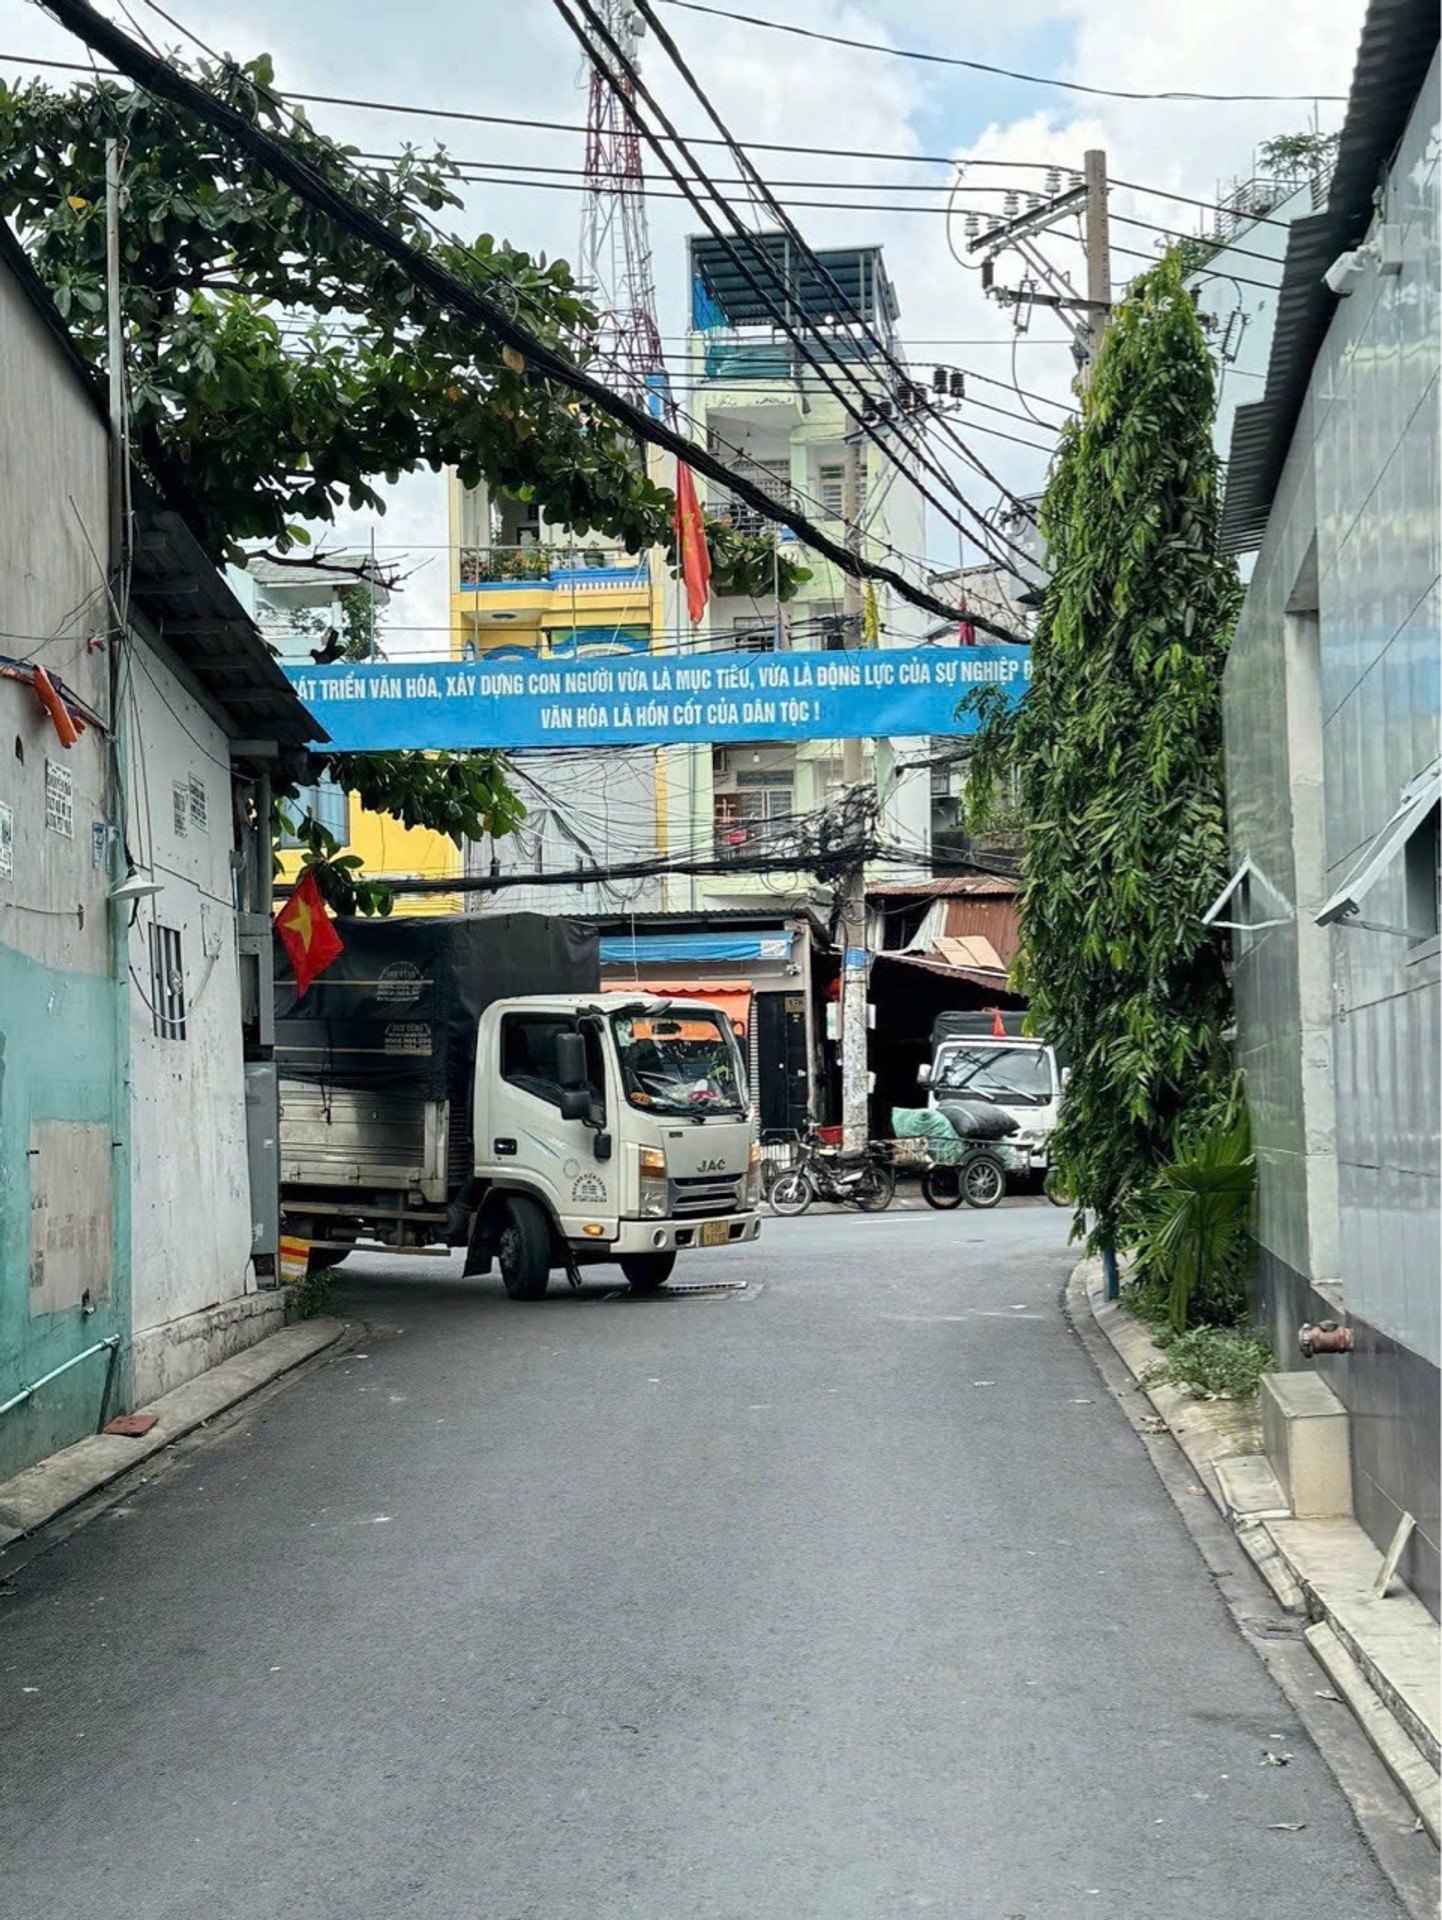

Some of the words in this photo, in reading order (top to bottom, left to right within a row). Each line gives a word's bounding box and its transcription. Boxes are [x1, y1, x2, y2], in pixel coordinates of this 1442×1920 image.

[320, 671, 366, 700] TRIỂN
[370, 674, 402, 698] VĂN
[406, 674, 441, 699] HÓA,
[446, 672, 476, 696] XÂY
[480, 672, 524, 700] DỰNG
[528, 672, 561, 694] CON
[565, 667, 613, 693] NGƯỜI
[617, 667, 648, 692] VỪA
[652, 666, 672, 691] LÀ
[676, 669, 711, 694] MỤC
[716, 664, 754, 690] TIÊU,
[758, 663, 789, 688] VỪA
[794, 661, 813, 687] LÀ
[816, 662, 860, 689] ĐỘNG
[864, 660, 894, 690] LỰC
[899, 656, 931, 685] CỦA
[935, 660, 957, 687] SỰ
[960, 656, 1019, 686] NGHIỆP
[540, 704, 572, 729] VĂN
[577, 703, 607, 728] HÓA
[613, 702, 633, 727] LÀ
[673, 698, 702, 725] CỐT
[707, 697, 739, 724] CỦA
[743, 698, 775, 723] DÂN
[780, 697, 809, 726] TỘC
[813, 701, 821, 721] !
[696, 1157, 726, 1173] JAC
